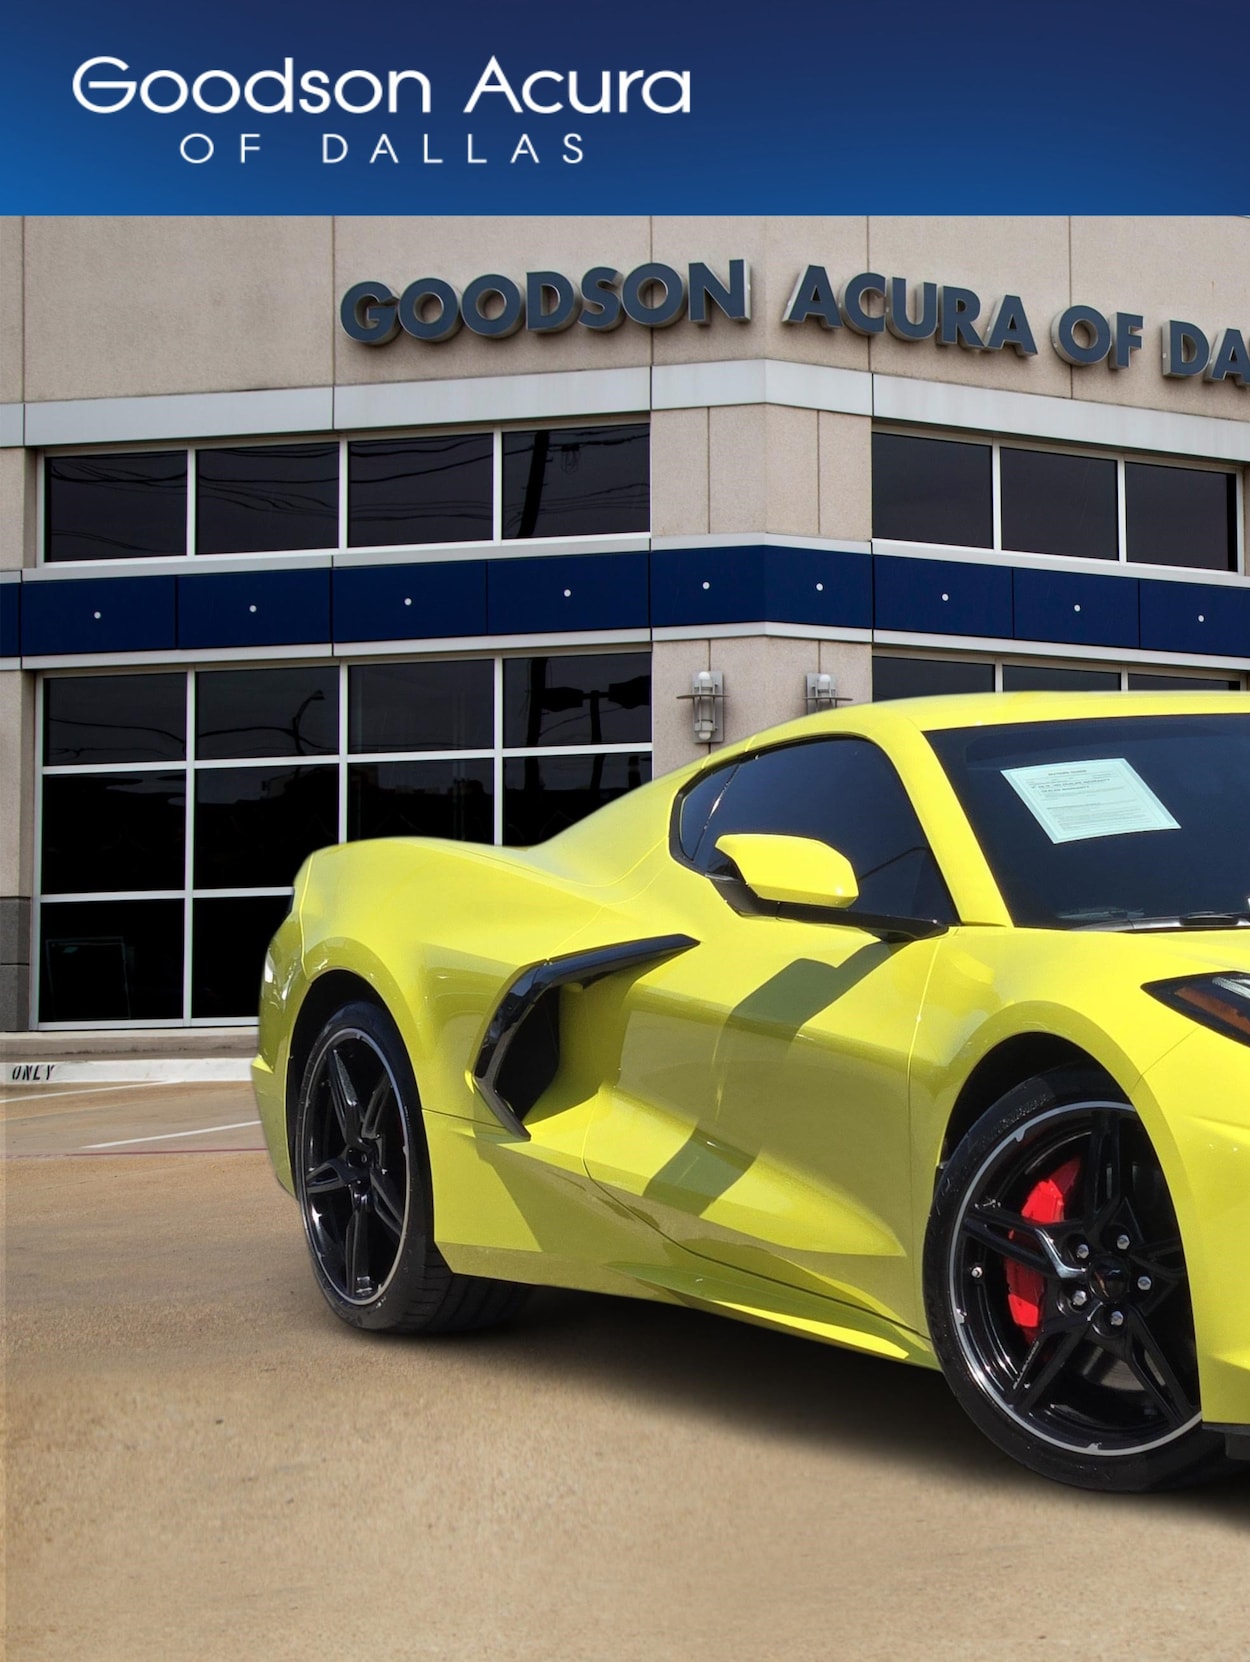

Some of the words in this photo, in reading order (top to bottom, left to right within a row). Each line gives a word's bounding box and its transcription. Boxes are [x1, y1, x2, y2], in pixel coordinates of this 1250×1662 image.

[340, 258, 752, 345] GOODSON
[783, 264, 1038, 357] ACURA
[1051, 304, 1144, 370] OF
[12, 1064, 55, 1081] ONLY
